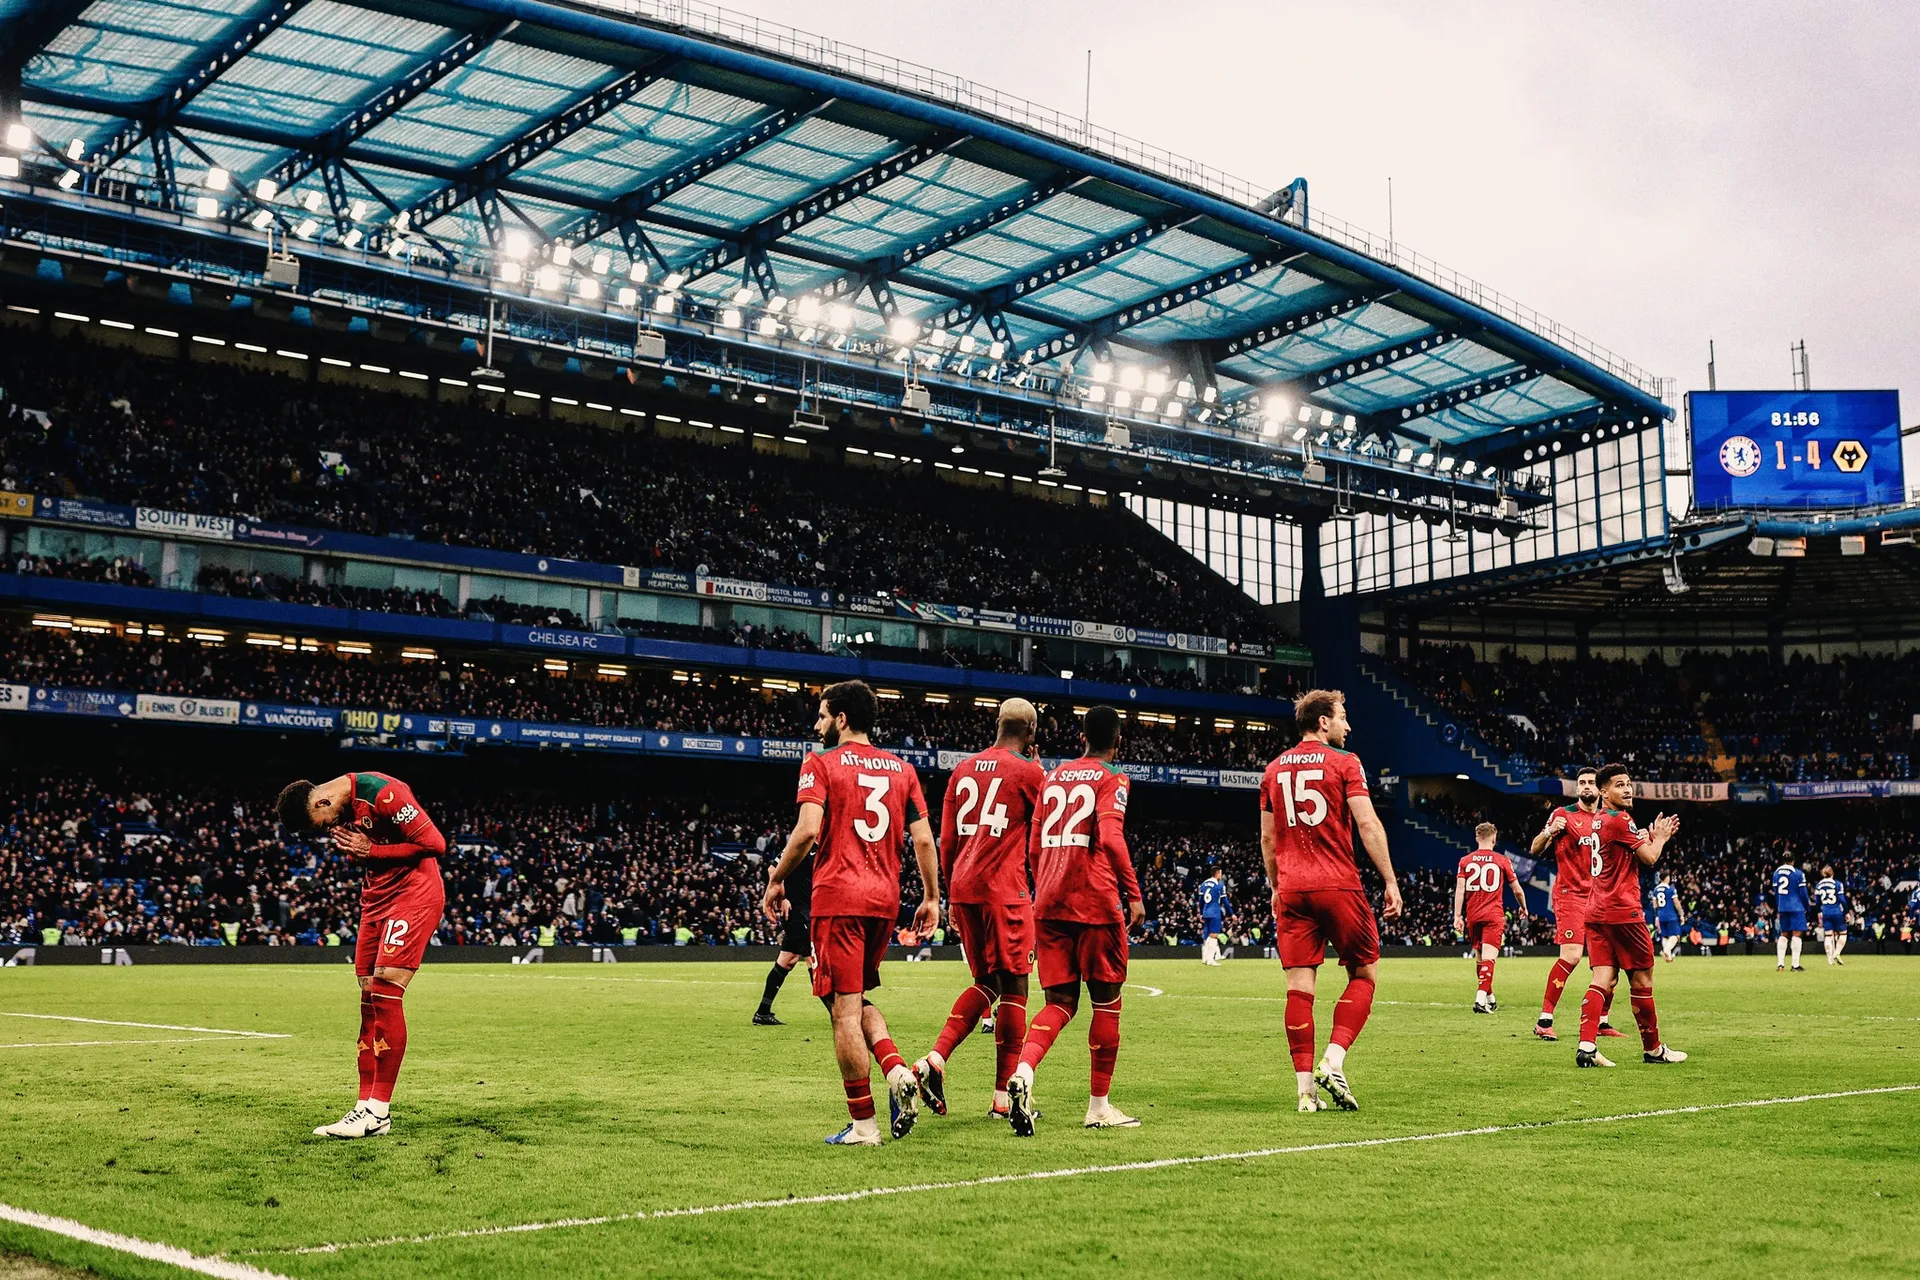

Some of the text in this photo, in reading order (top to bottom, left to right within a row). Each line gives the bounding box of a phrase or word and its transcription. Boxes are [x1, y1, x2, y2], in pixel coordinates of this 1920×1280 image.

[1771, 412, 1820, 426] 81:56
[139, 508, 232, 532] SOUTH WEST
[651, 571, 686, 582] AMERICAN
[648, 580, 689, 590] HEARTLAND
[715, 585, 753, 597] MALTA
[772, 595, 793, 603] SOUTH
[793, 597, 812, 606] WALES
[792, 590, 809, 598] BATH
[868, 605, 884, 614] Blues
[881, 599, 895, 607] York
[1030, 615, 1071, 627] MELBOURNE
[1030, 625, 1071, 636] CHELSEA
[529, 631, 598, 649] CHELSEA FC
[152, 702, 225, 717] ENNIS BLUES
[265, 713, 333, 728] VANCOUVER
[522, 728, 642, 743] SUPPORT CHELSEA SUPPORT EQUALITY
[684, 739, 696, 748] NO
[762, 740, 803, 750] CHELSEA
[762, 748, 801, 759] CROATIA
[1280, 753, 1325, 765] DAWSON
[840, 750, 903, 773] AÏT-NOURI
[975, 760, 997, 772] TOTI
[1059, 769, 1104, 782] SEMEDO
[1168, 767, 1203, 776] MID-ATLANTIC
[1222, 774, 1259, 786] HASTINGS
[1277, 769, 1327, 827] 15
[1635, 783, 1713, 799] A LEGEND
[854, 773, 890, 842] 3
[956, 776, 1009, 838] 24
[1041, 783, 1096, 849] 22
[1591, 832, 1603, 877] 8
[1465, 862, 1500, 892] 20
[1778, 876, 1789, 895] 2
[1204, 888, 1212, 904] 6
[1656, 892, 1666, 908] 8
[1820, 889, 1837, 905] 23
[384, 919, 409, 946] 12
